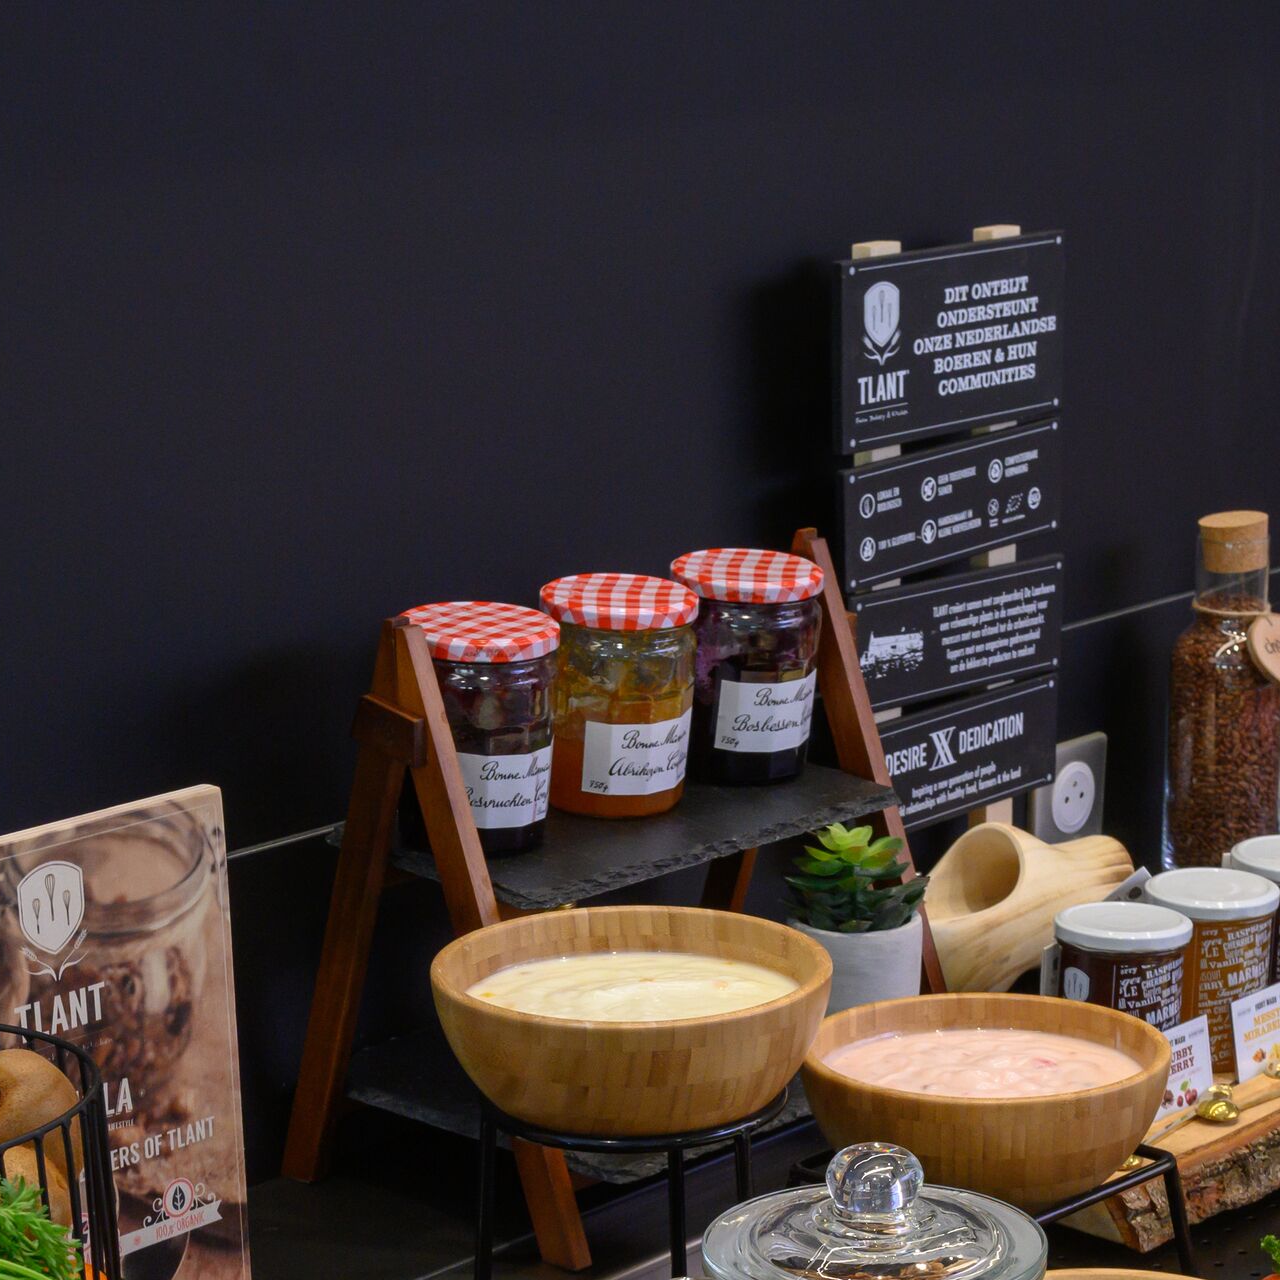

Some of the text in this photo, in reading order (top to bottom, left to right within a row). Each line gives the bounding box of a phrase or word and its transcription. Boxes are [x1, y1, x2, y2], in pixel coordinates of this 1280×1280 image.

[944, 276, 1029, 304] DIT ONTBIJT
[937, 296, 1039, 328] ONDERSTEUNT
[913, 316, 1057, 355] ONZE NEDERLANDSE
[933, 341, 1038, 374] BOEREN & HUN
[857, 370, 907, 406] TLANT
[938, 363, 1036, 397] COMMUNITIES
[885, 742, 928, 777] DESIRE
[958, 711, 1025, 755] DEDICATION
[480, 760, 521, 781] Bonne
[14, 981, 105, 1044] TLANT
[1253, 1008, 1280, 1026] MESSY
[1170, 1057, 1195, 1076] ERRY
[1172, 1045, 1193, 1063] UBBY
[109, 1116, 215, 1172] ERS OF TLANT
